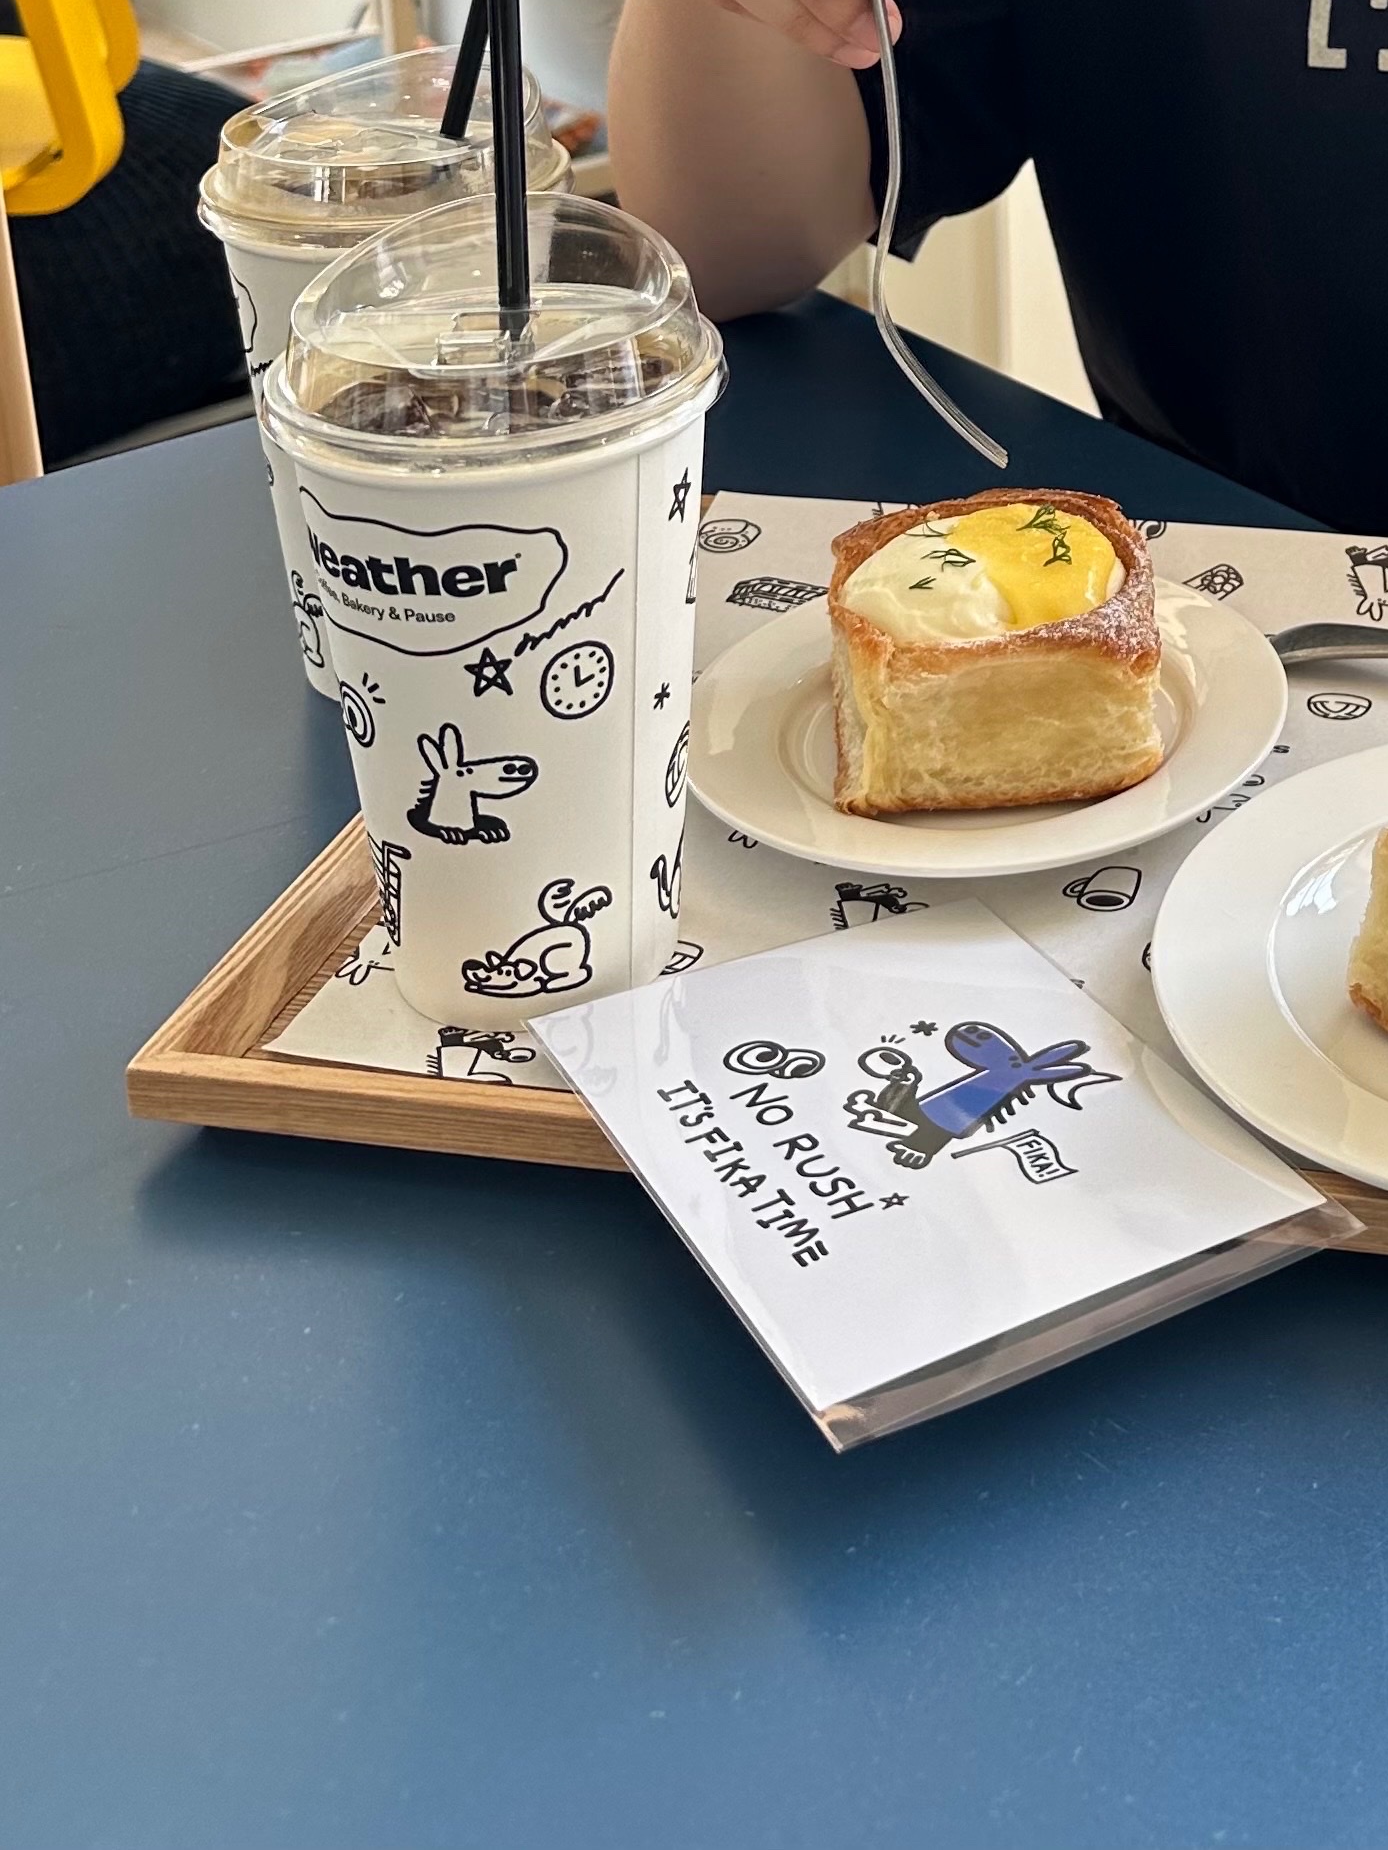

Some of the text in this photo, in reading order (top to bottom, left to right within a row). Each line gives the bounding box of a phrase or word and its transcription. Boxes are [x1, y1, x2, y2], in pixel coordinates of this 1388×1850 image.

[341, 591, 386, 621] Bakery
[388, 606, 402, 622] &
[404, 608, 456, 623] Pause
[657, 1080, 715, 1127] IT'S
[729, 1082, 794, 1126] NO
[684, 1126, 767, 1198] FIKA
[772, 1133, 875, 1220] RUSH
[1016, 1139, 1060, 1178] FIKA!
[751, 1188, 830, 1268] TIME
